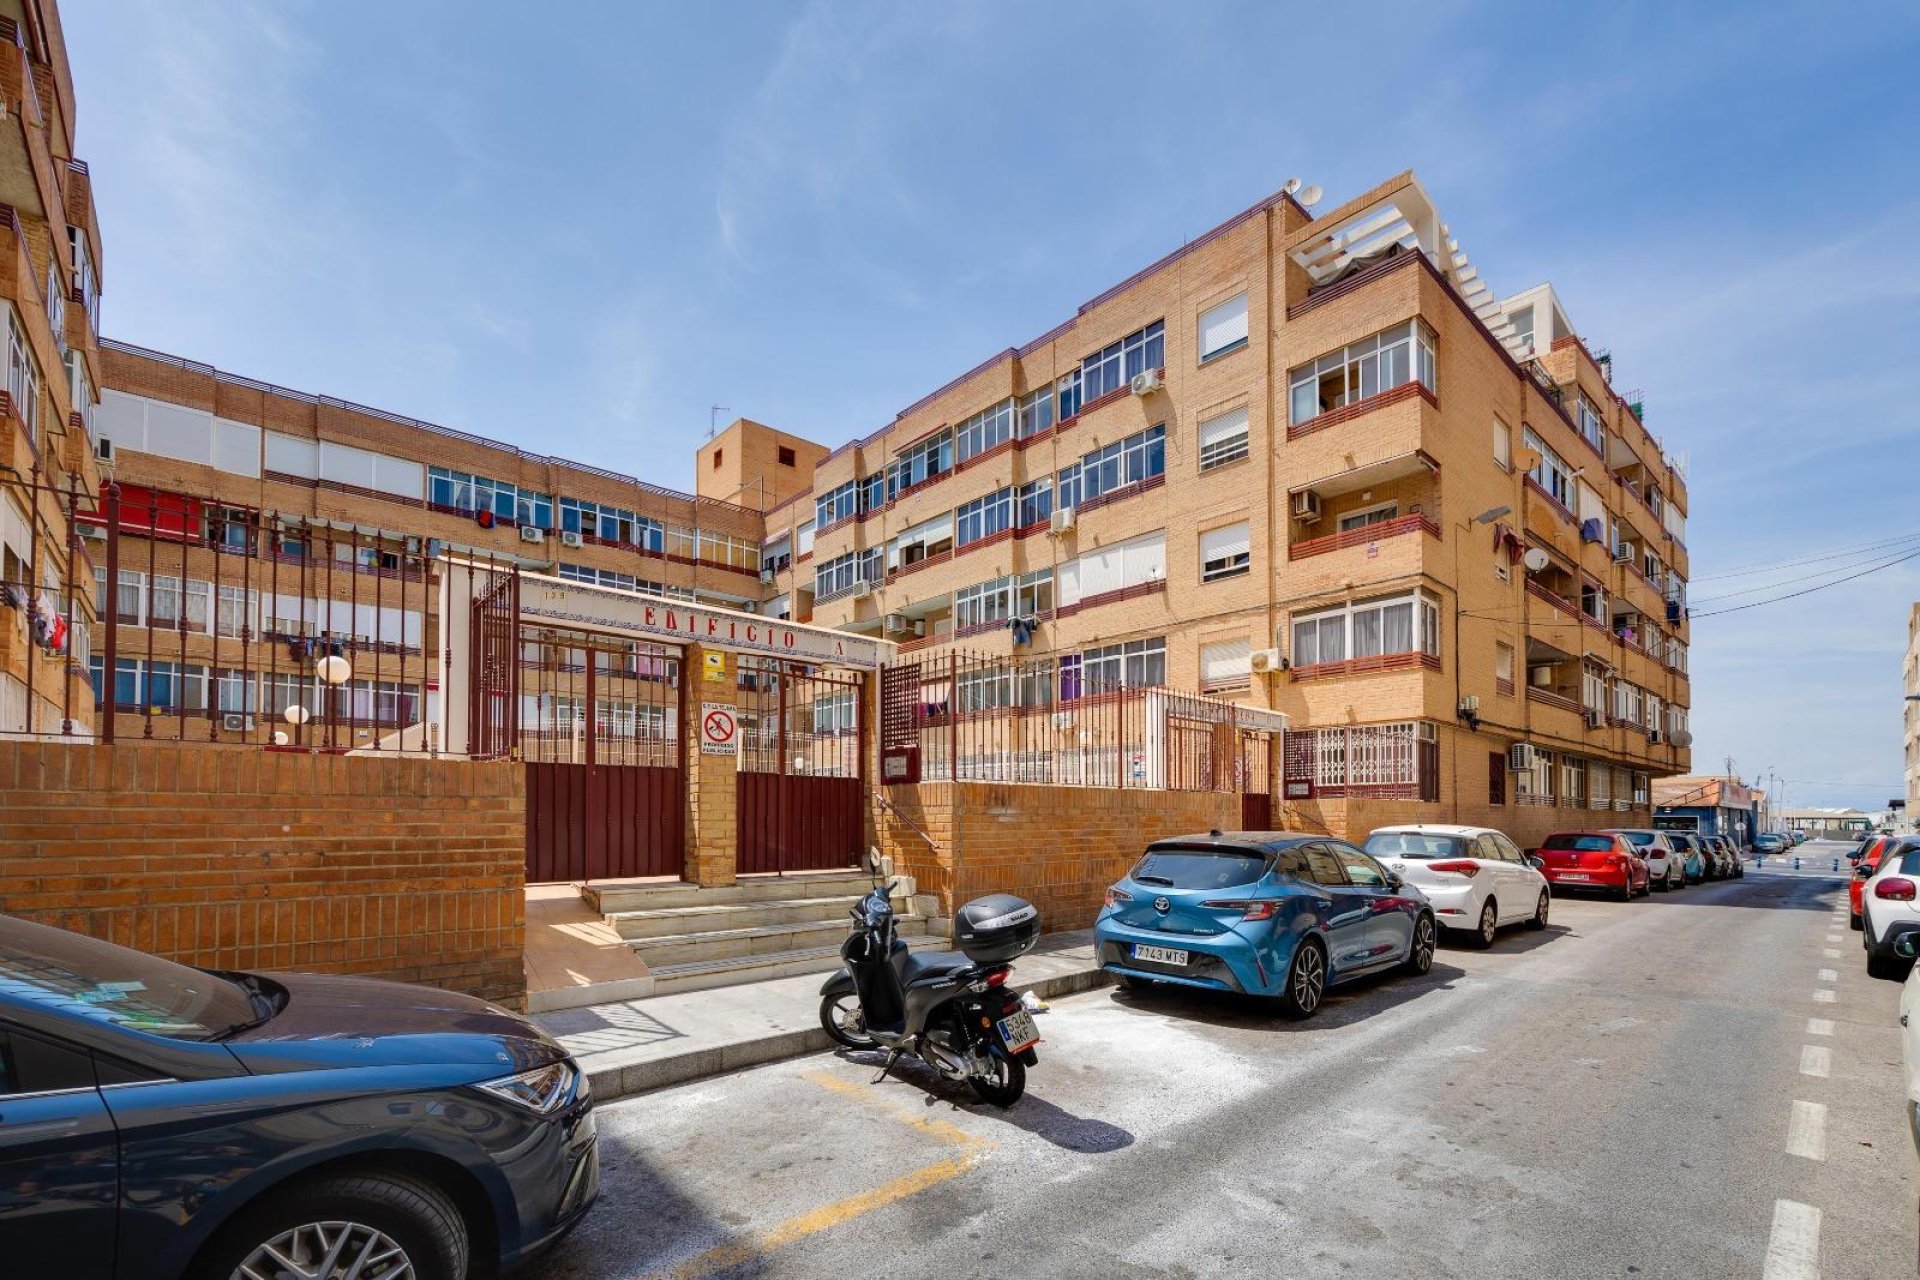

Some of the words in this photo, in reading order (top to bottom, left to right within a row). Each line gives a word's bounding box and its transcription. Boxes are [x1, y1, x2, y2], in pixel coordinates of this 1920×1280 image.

[645, 607, 795, 648] EDIFICIO
[834, 642, 843, 656] A
[1138, 946, 1162, 960] 7143
[1166, 951, 1185, 964] MTS
[1006, 1011, 1031, 1032] 5348
[1012, 1026, 1029, 1044] NKF
